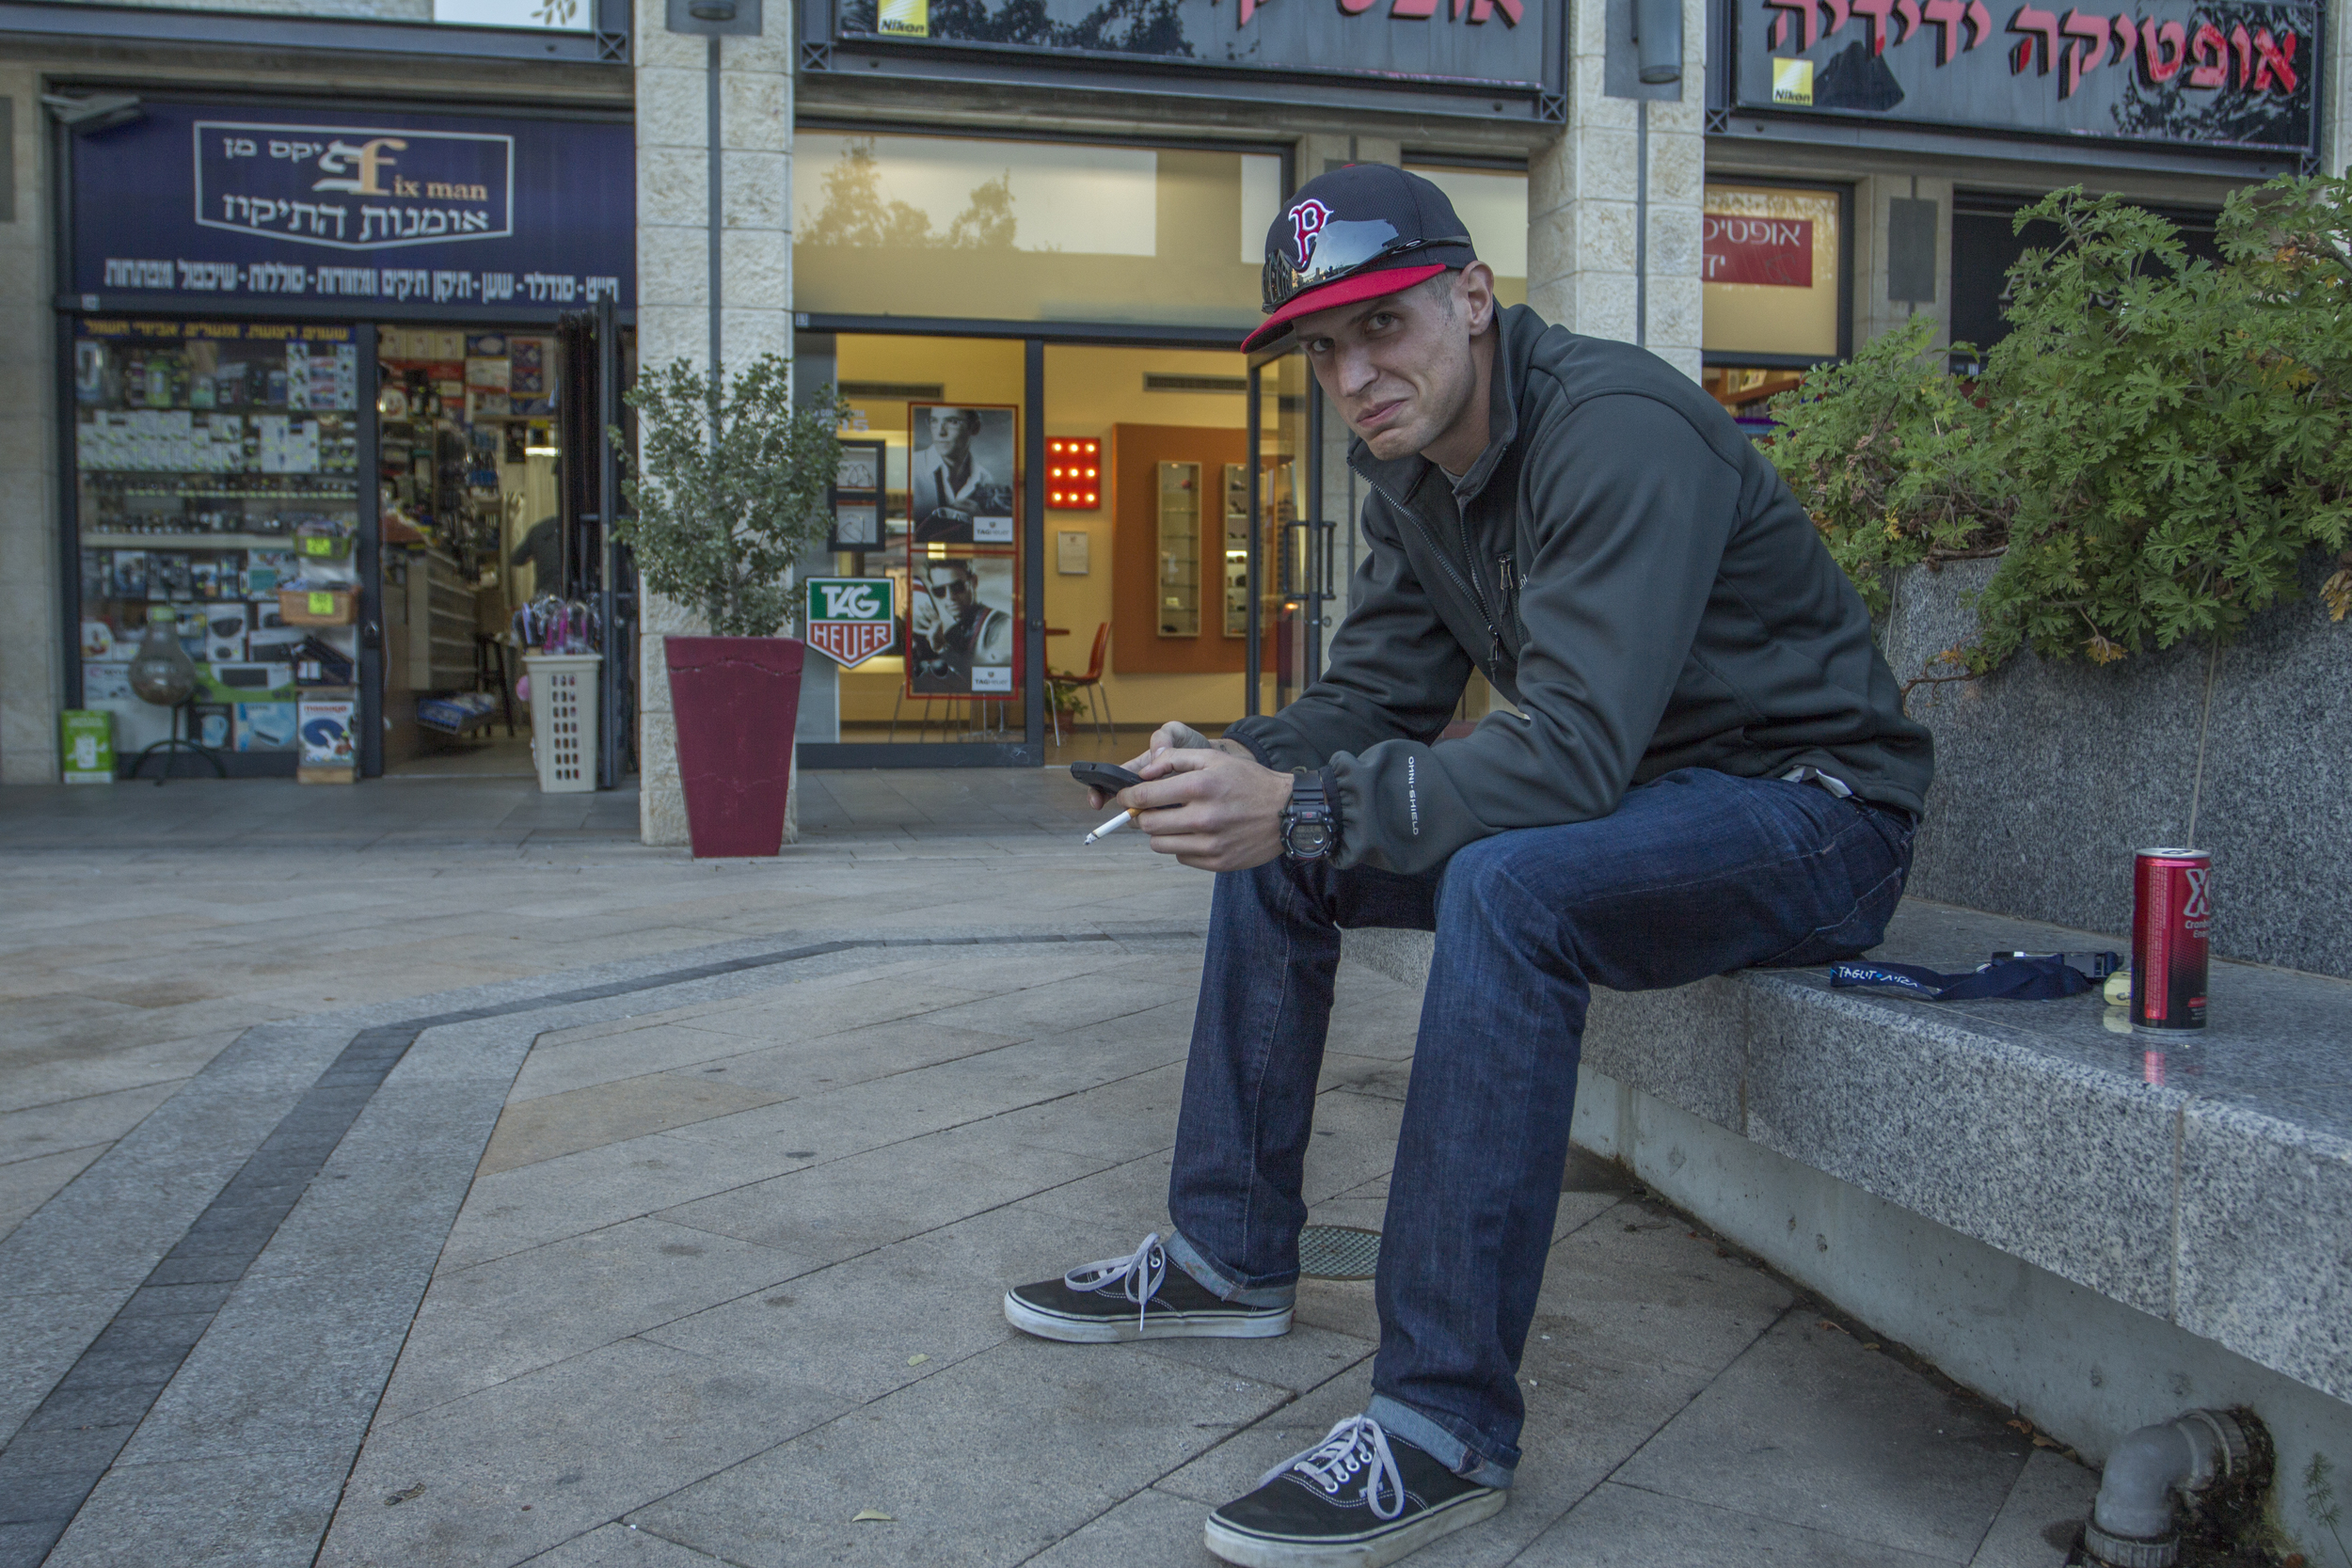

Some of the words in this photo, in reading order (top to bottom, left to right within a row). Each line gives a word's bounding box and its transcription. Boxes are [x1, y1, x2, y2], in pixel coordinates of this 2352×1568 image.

[880, 19, 925, 34] Nikon
[1764, 0, 1992, 69] ידידיה
[2007, 3, 2297, 100] אופטיקה
[1774, 87, 1811, 103] Nikon
[223, 137, 258, 160] מן
[425, 181, 488, 201] man
[222, 193, 348, 240] התיקון
[358, 204, 490, 242] אומנות
[103, 257, 175, 290] מפתחות
[381, 267, 428, 303] תיקים
[481, 271, 515, 305] שען
[523, 271, 576, 302] סנדלר
[820, 584, 881, 619] TAG
[814, 626, 887, 659] HEUER
[1407, 755, 1420, 836] OMNI-SHIELD
[1838, 966, 1878, 980] TAGLIT
